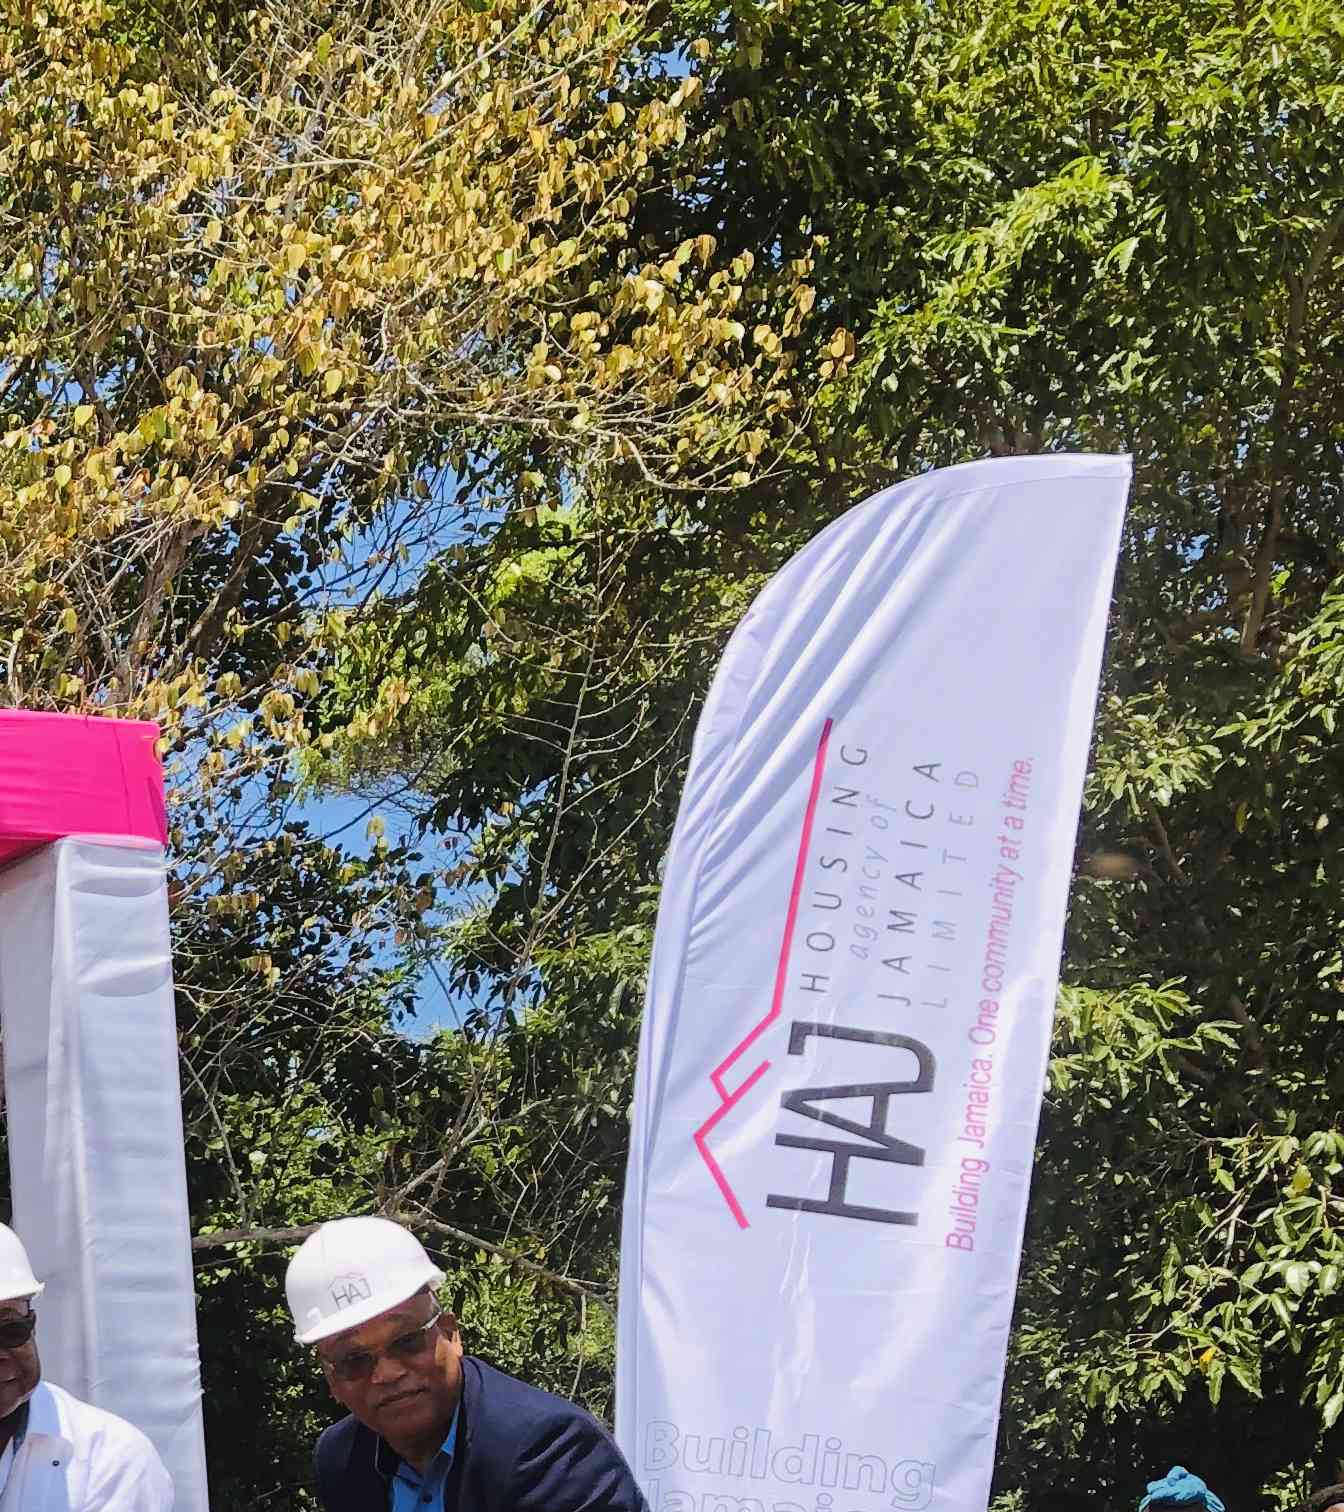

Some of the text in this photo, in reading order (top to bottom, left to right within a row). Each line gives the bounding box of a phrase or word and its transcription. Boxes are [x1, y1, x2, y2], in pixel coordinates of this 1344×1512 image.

[799, 744, 869, 993] HOUSING
[848, 794, 899, 962] agency of
[877, 760, 943, 1007] JAMAICA
[922, 769, 980, 1009] LIMITED
[945, 757, 1035, 1252] Building Jamaica. One community at a time.
[766, 1021, 937, 1227] HAJ
[330, 1277, 373, 1312] HAJ
[643, 1420, 937, 1512] Building
